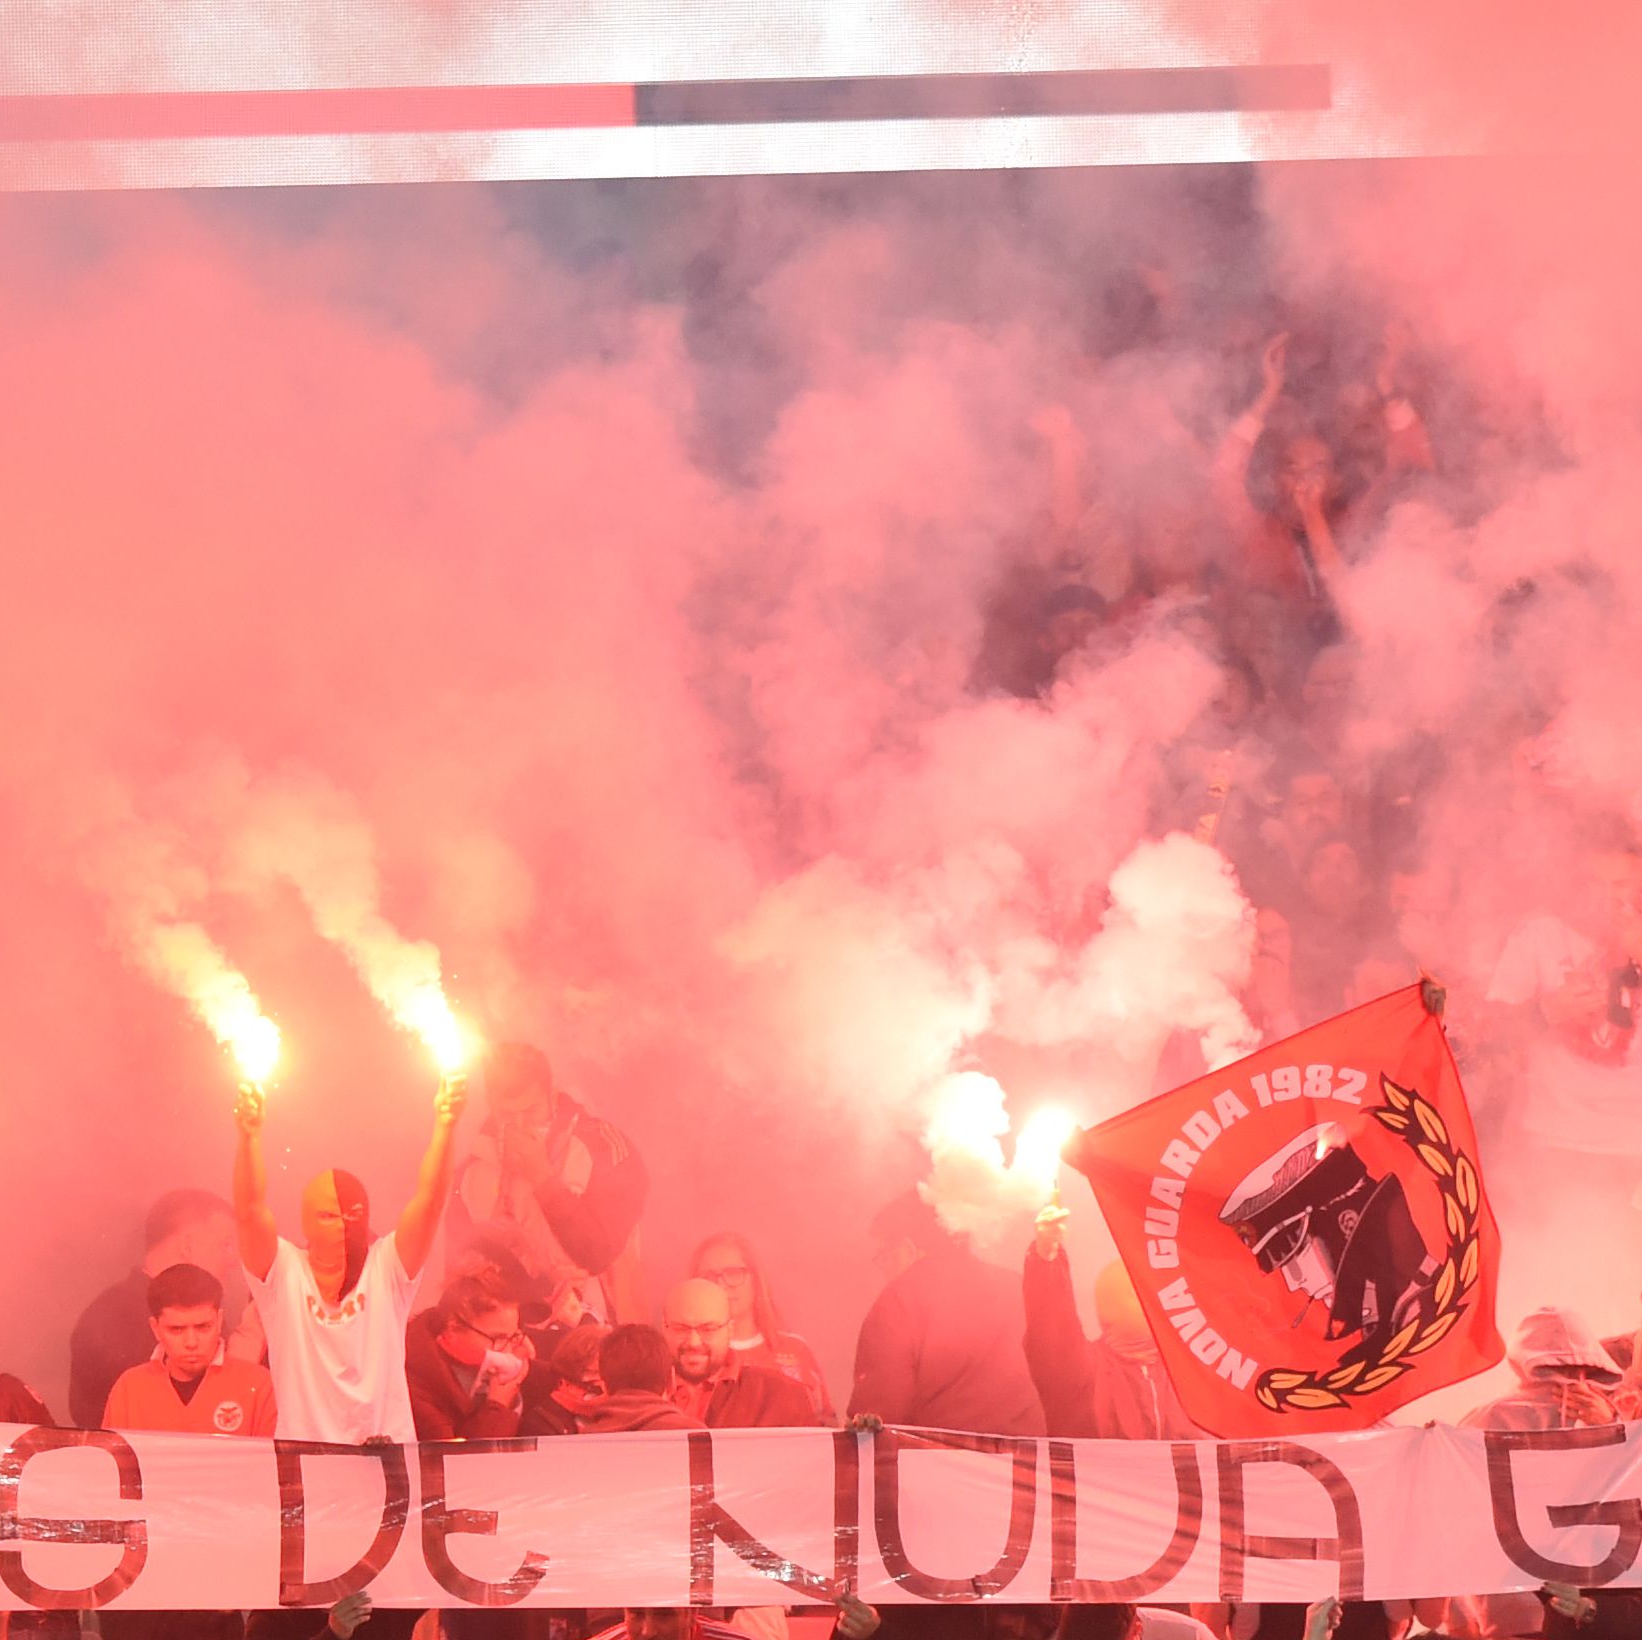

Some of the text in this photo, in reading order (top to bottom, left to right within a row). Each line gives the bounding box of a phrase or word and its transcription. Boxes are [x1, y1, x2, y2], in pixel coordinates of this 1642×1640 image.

[1145, 1064, 1368, 1392] NOVA GUARDA 1982
[275, 1436, 549, 1609] DE
